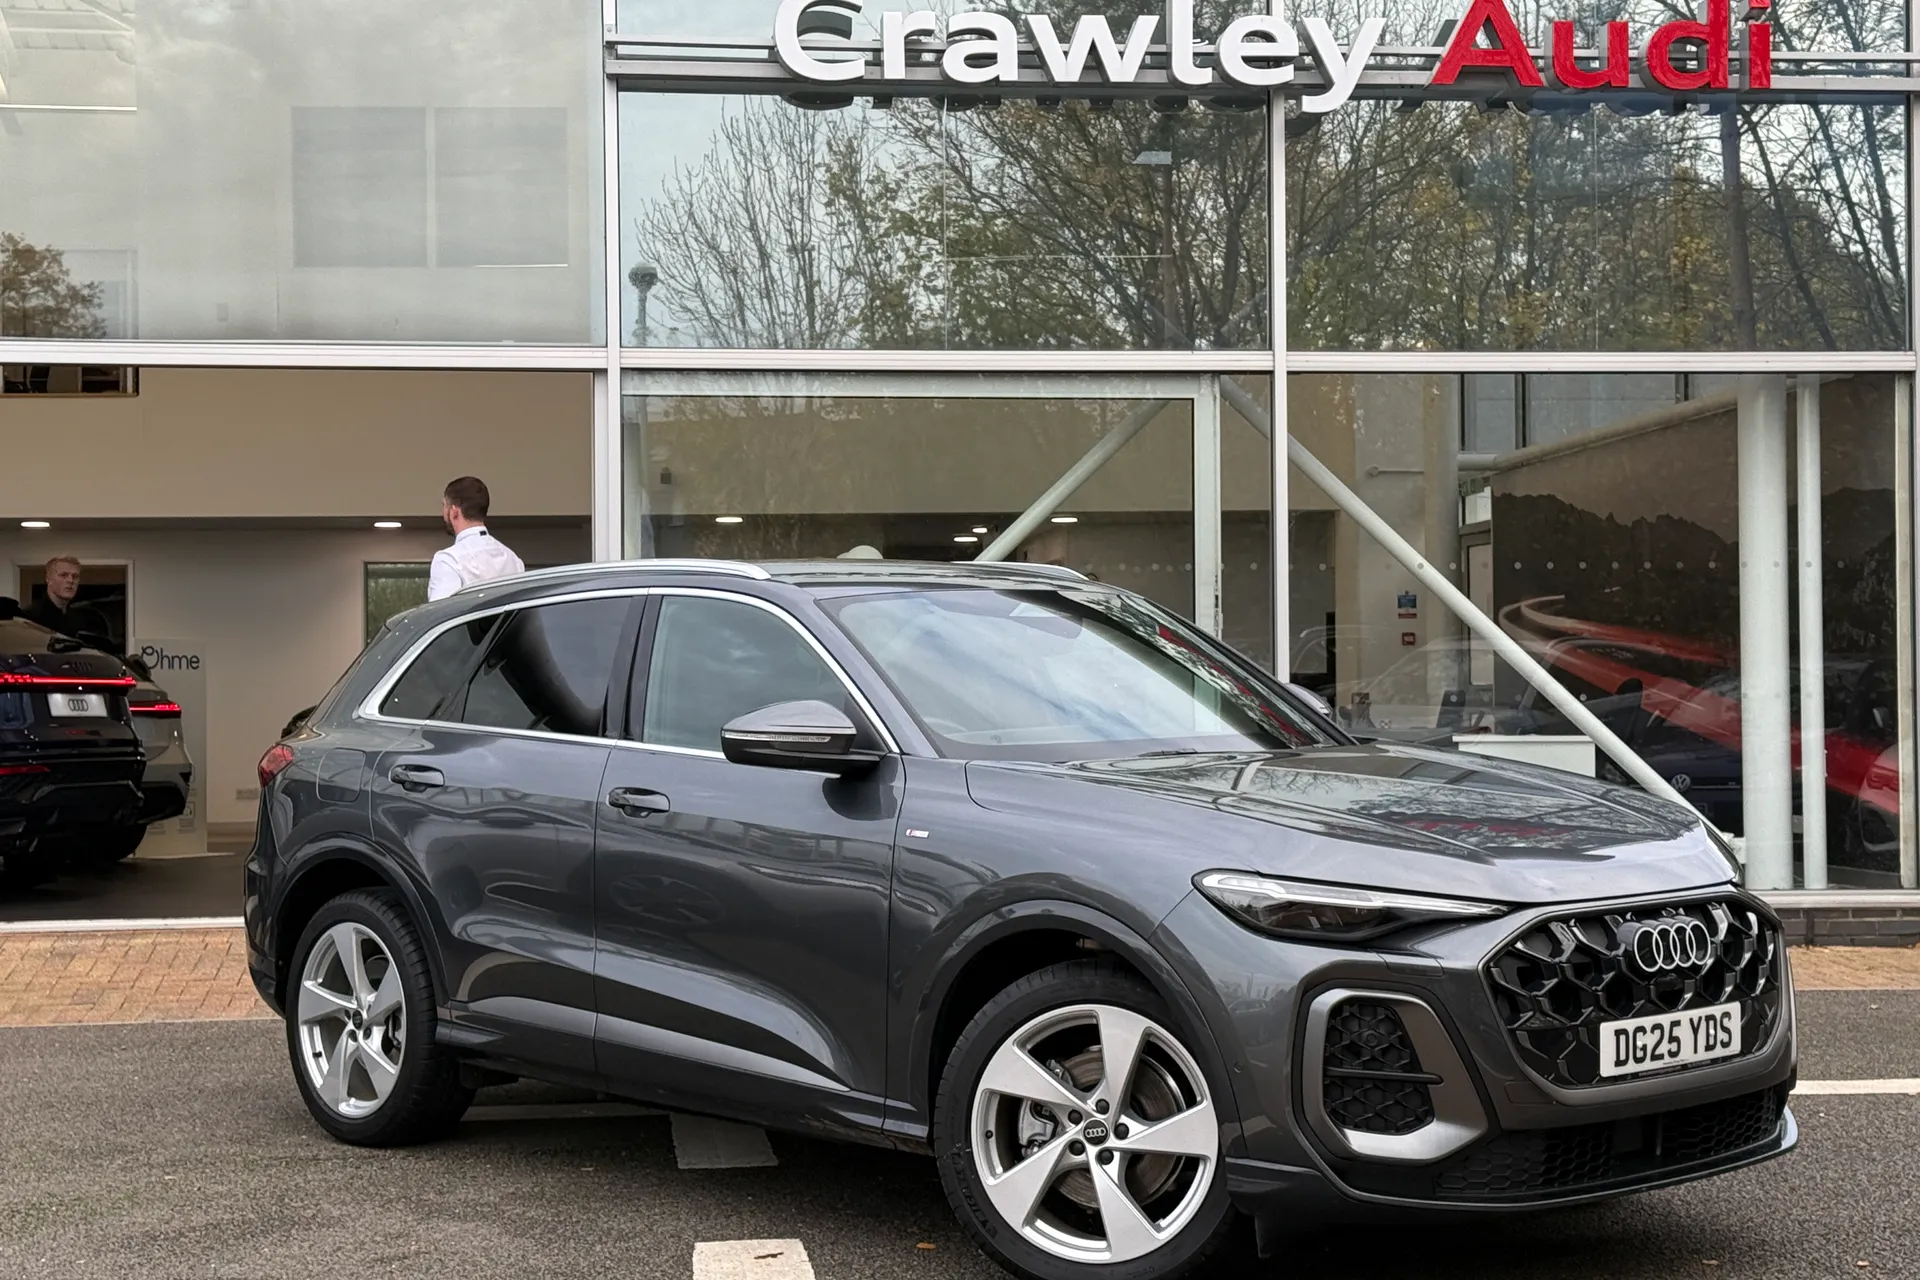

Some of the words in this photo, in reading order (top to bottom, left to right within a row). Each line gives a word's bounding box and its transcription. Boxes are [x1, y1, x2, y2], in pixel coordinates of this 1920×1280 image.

[773, 0, 1385, 114] Crawley
[1429, 0, 1771, 91] Audi
[140, 646, 200, 670] Ohme
[1613, 1020, 1682, 1068] DG25
[1689, 1011, 1733, 1055] YDS
